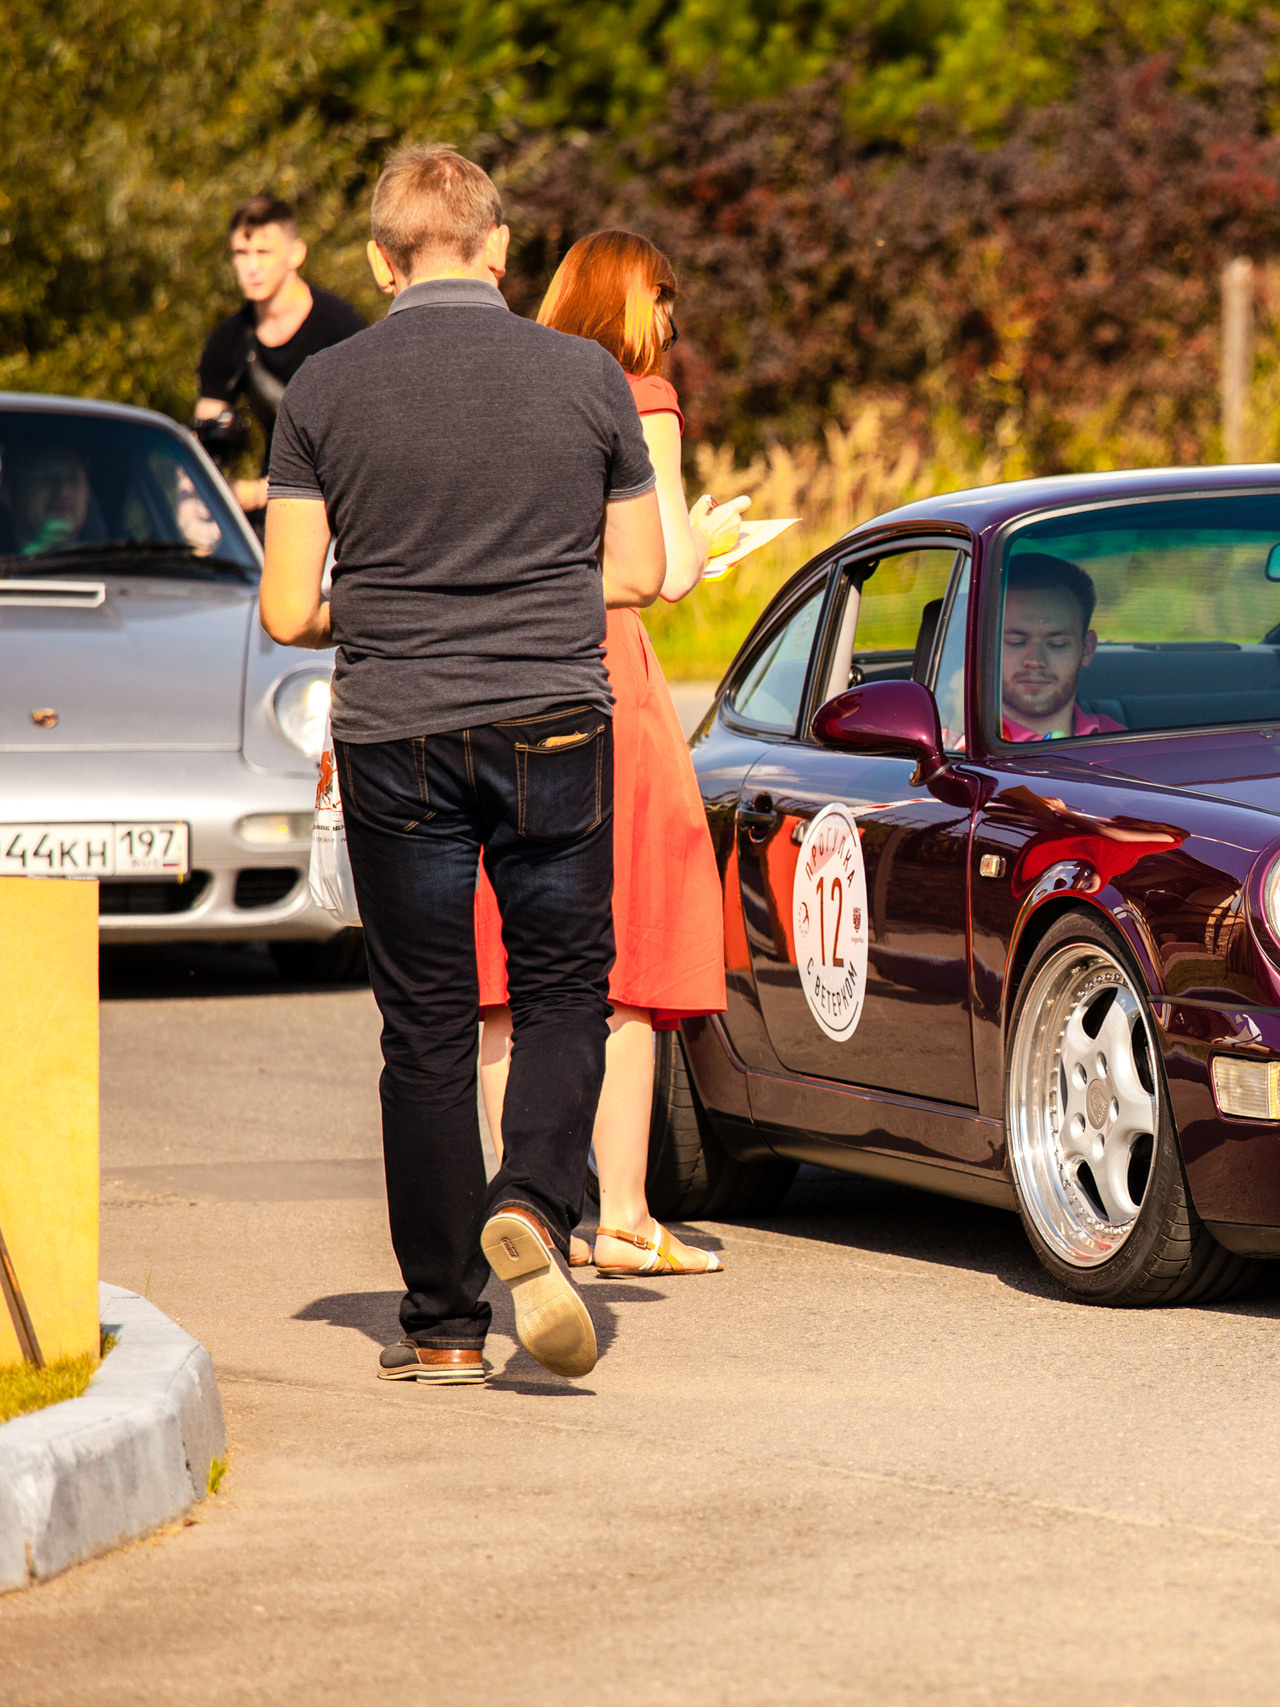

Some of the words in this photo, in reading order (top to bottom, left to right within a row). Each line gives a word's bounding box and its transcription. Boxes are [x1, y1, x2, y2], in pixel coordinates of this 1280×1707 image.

[0, 832, 106, 867] 44KH
[120, 830, 175, 856] 197
[805, 827, 855, 888] ПРОГУЛКА
[816, 876, 844, 968] 12
[814, 960, 857, 1017] ВЕТЕРКОМ
